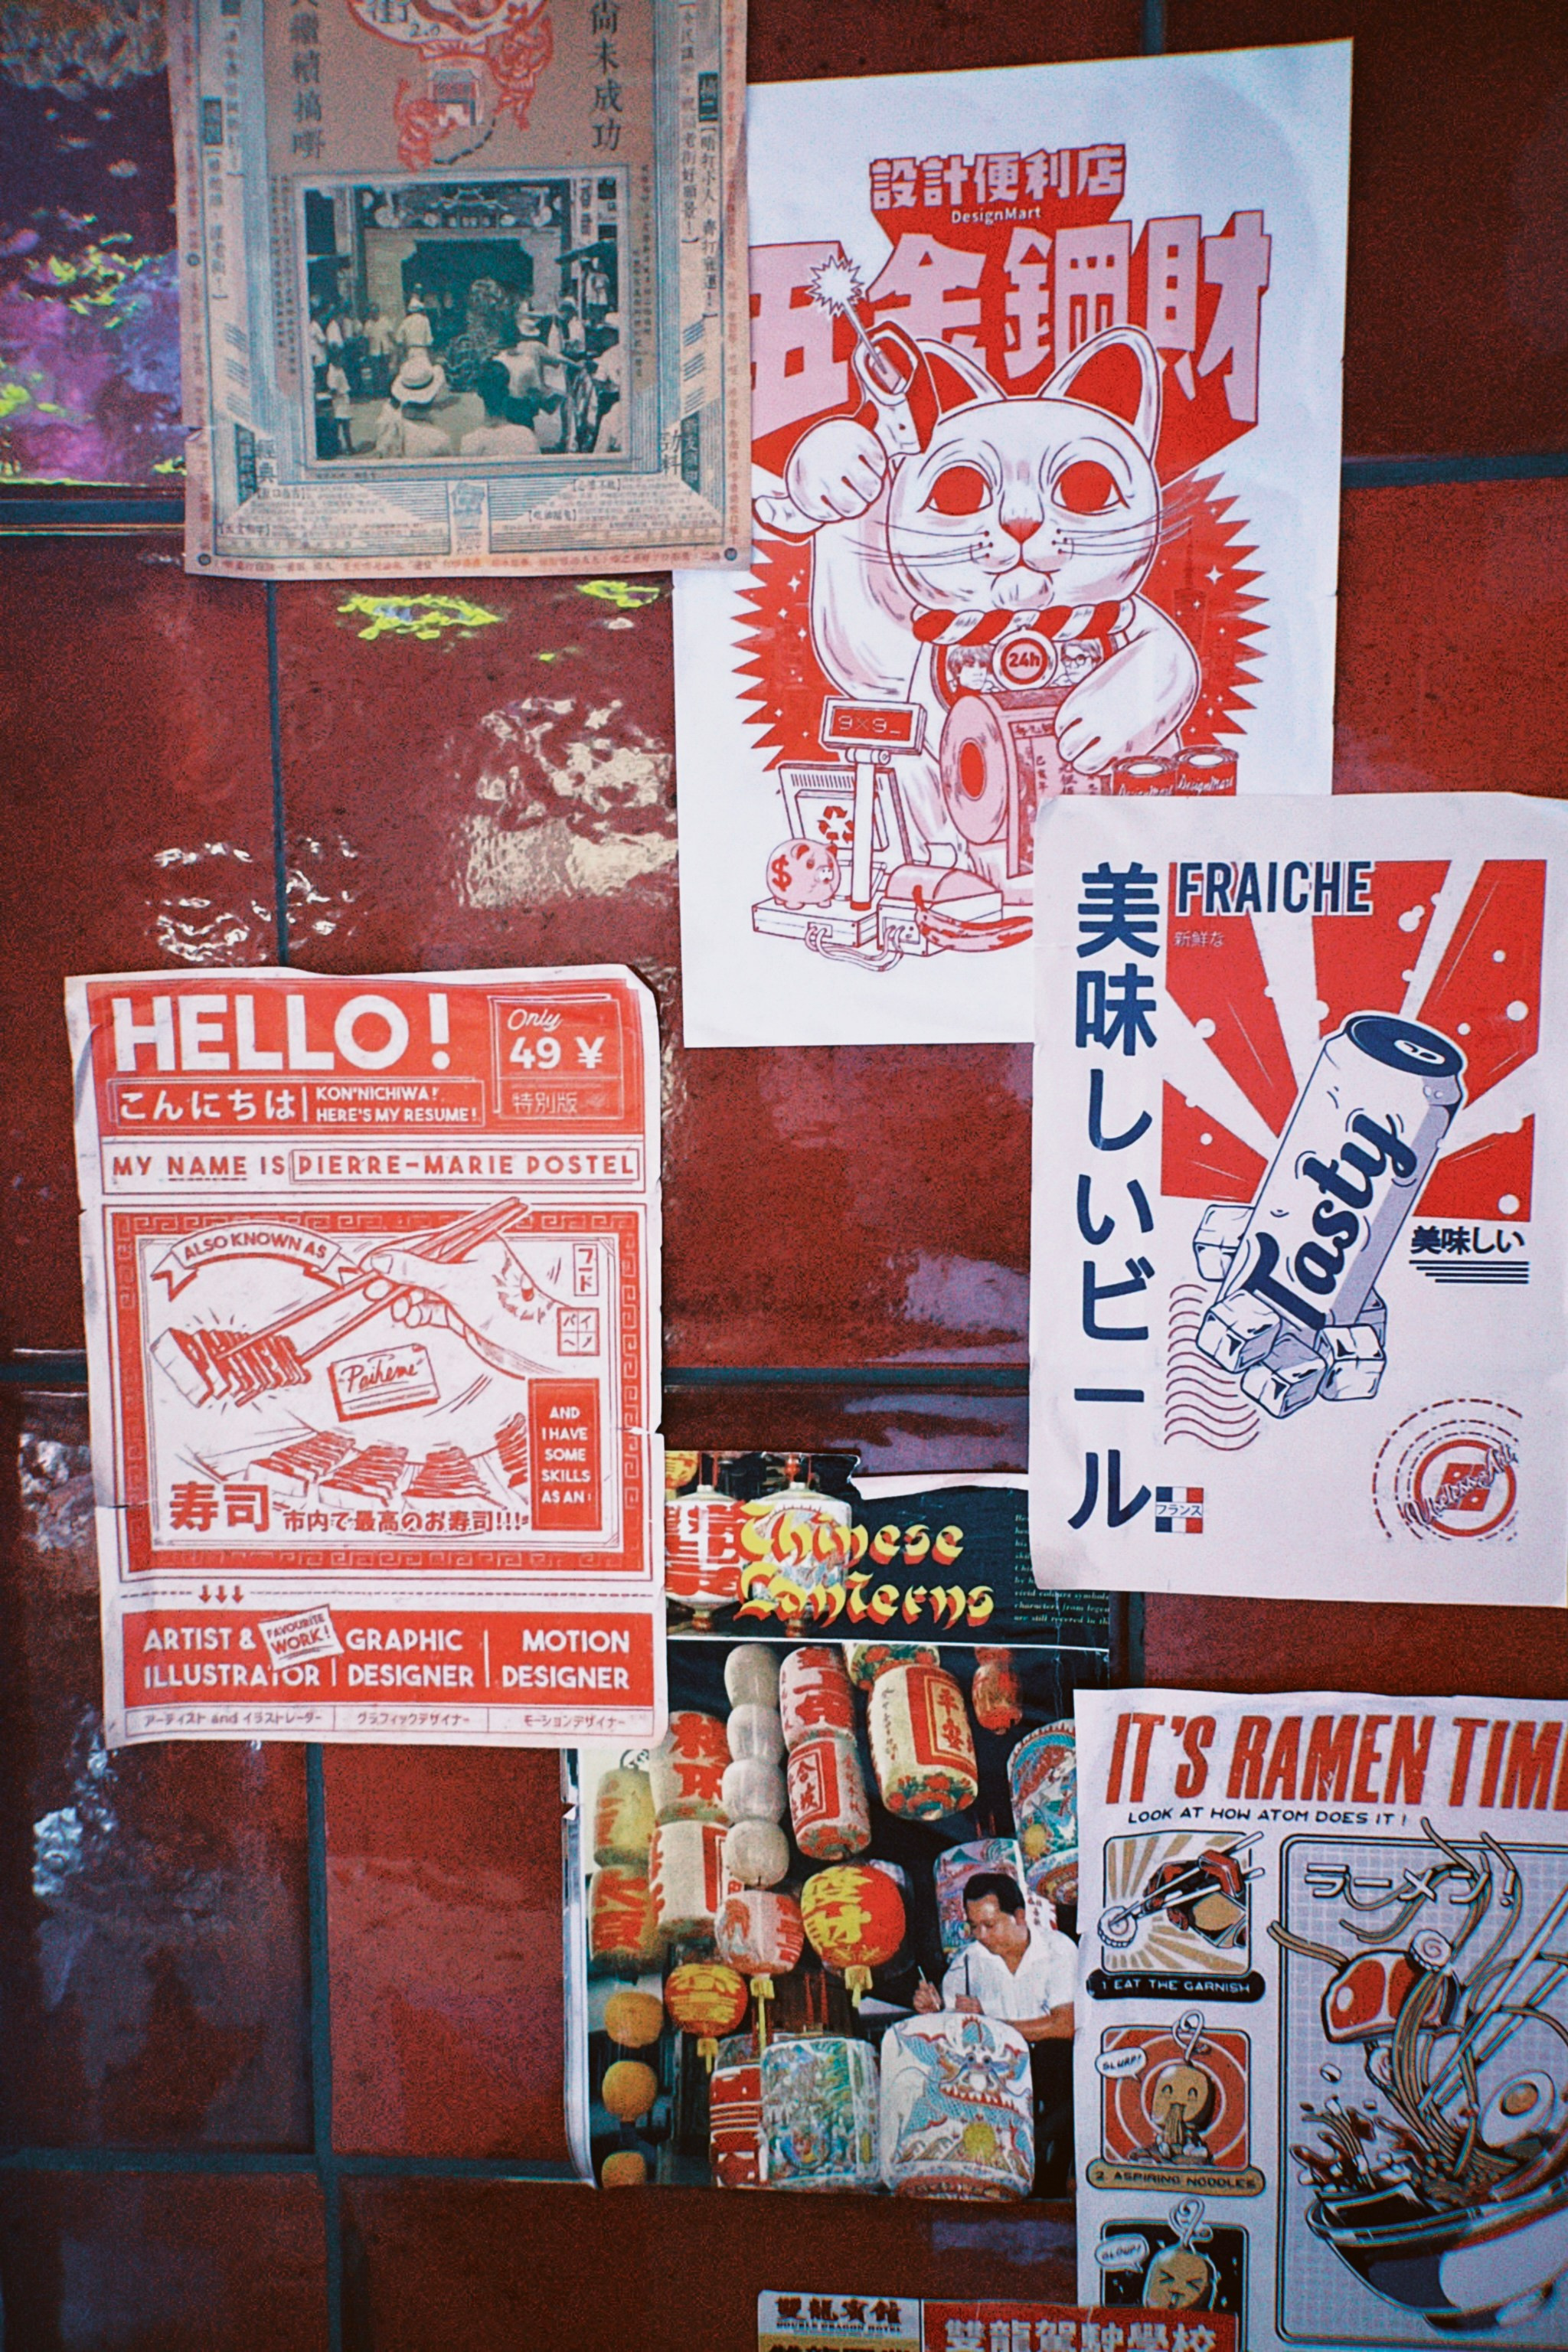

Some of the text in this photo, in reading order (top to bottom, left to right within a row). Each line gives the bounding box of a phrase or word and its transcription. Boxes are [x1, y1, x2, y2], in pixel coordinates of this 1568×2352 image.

[871, 145, 1125, 210] 設計便利店
[951, 205, 1041, 226] DesignMart
[1008, 652, 1040, 668] 24h
[1178, 861, 1374, 915] FRAICHE
[507, 1008, 564, 1032] Only
[509, 1036, 606, 1070] 49 ¥
[118, 1087, 296, 1122] こんにちは
[315, 1107, 478, 1123] HERE'S MY RESUME!
[113, 1154, 635, 1177] MY NAME IS PIERRE-MARIE POSTEL
[1067, 861, 1161, 1530] 美味しいビール
[1240, 1113, 1417, 1331] Tasty
[184, 1232, 328, 1262] ALSO KNOWN AS
[1410, 1227, 1526, 1256] 美味しい
[549, 1406, 581, 1419] AND
[541, 1427, 589, 1441] I HAVE
[544, 1448, 586, 1462] SOME
[541, 1468, 591, 1483] SKILLS
[169, 1482, 270, 1532] 寿司
[541, 1490, 560, 1504] AS
[1155, 1504, 1203, 1517] フランス
[738, 1498, 965, 1568] Chinese
[733, 1562, 995, 1631] Lanterns
[142, 1627, 256, 1652] ARTIST &
[345, 1628, 464, 1653] GRAPHIC
[522, 1628, 630, 1653] MOTION
[348, 1664, 474, 1688] DESIGNER
[501, 1665, 630, 1690] DESIGNER
[211, 1712, 239, 1726] and
[1105, 1712, 1217, 1805] IT'S
[1226, 1714, 1436, 1805] RAMEN
[1128, 1807, 1173, 1824] LOOK
[1180, 1807, 1205, 1819] AT
[1210, 1808, 1254, 1822] HOW
[1256, 1809, 1309, 1824] ATOM
[1316, 1810, 1369, 1825] DOES
[1112, 1978, 1143, 1992] EAT
[1148, 1981, 1178, 1992] THE
[1183, 1982, 1251, 1994] GARNISH
[1096, 2171, 1256, 2190] 2 ASPIRING NOODLES
